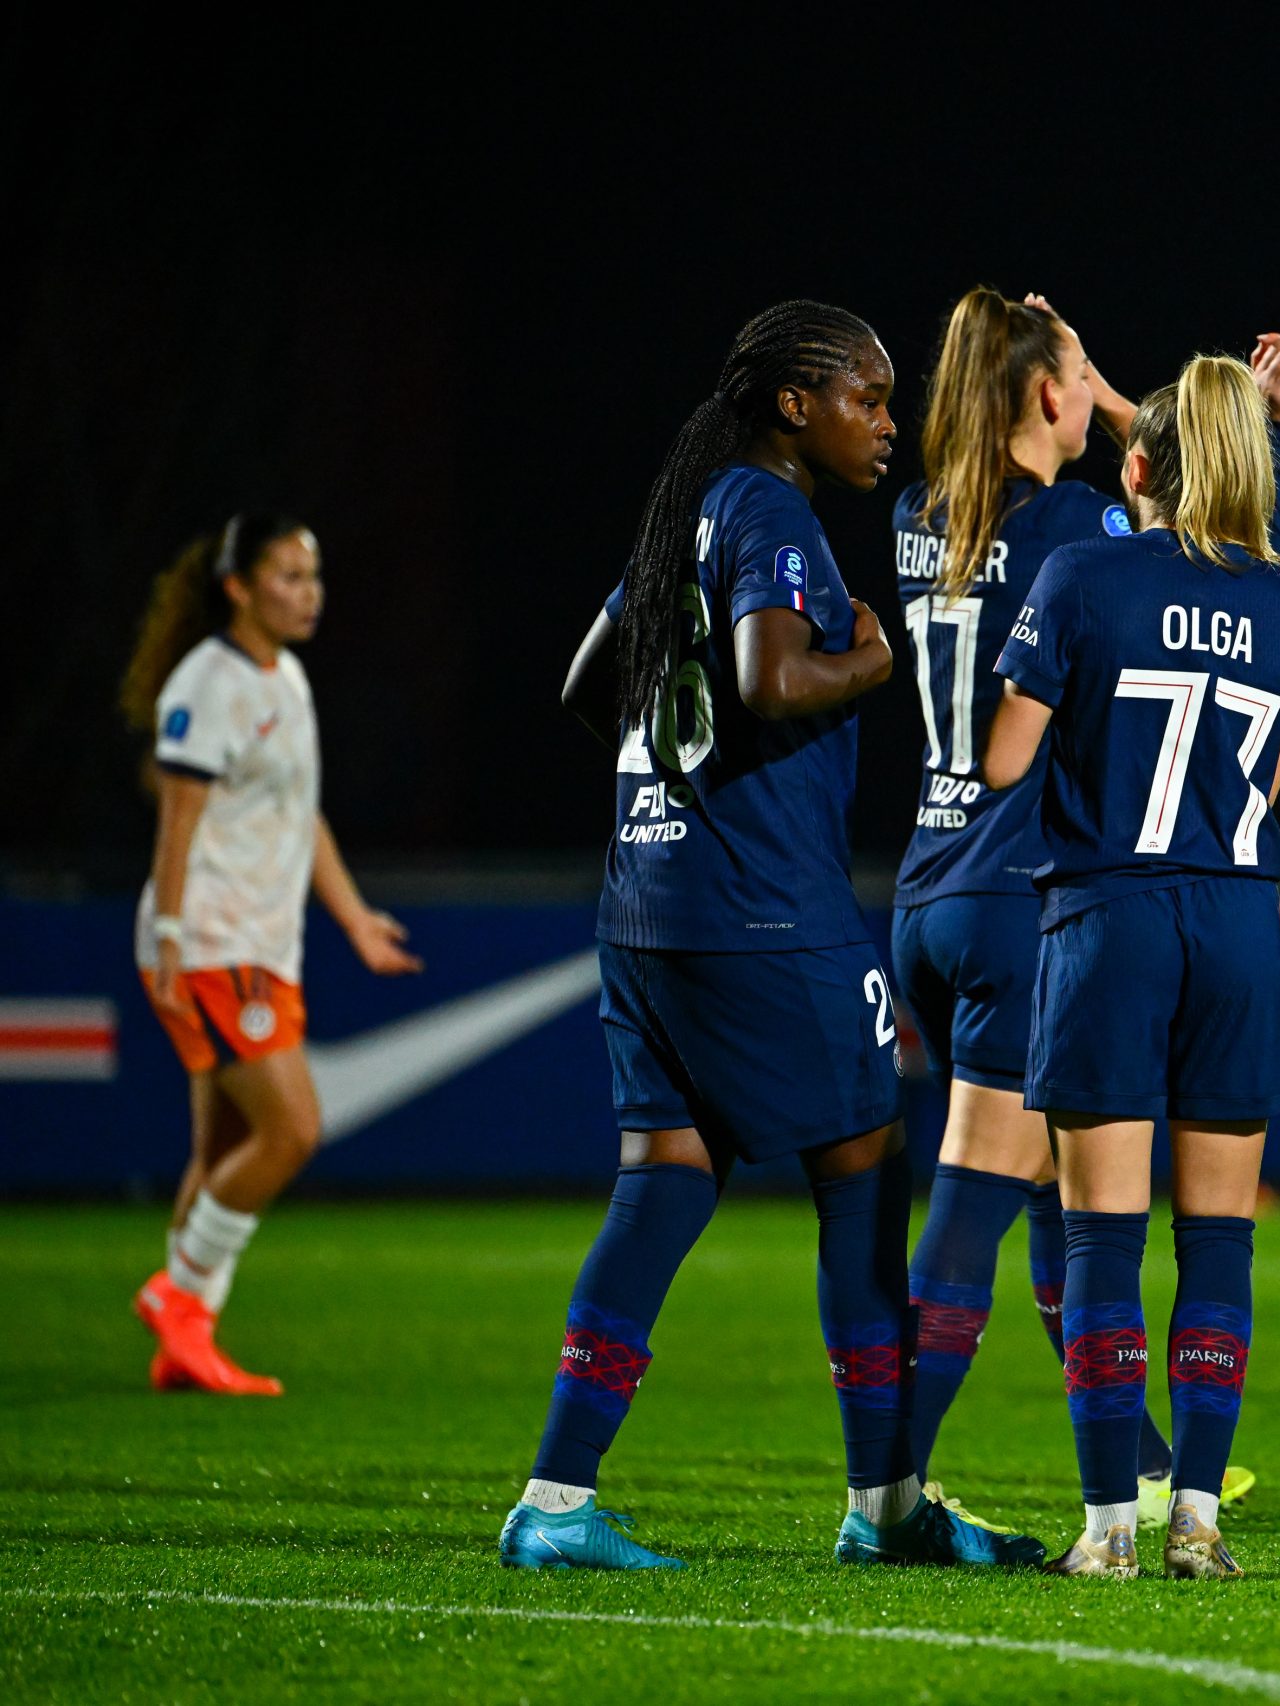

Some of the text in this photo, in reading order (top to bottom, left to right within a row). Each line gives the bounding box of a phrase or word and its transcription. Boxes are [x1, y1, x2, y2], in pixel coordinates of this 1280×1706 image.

[896, 530, 1009, 583] LEUCR
[1162, 604, 1253, 664] OLGA
[905, 594, 984, 775] 17
[619, 820, 687, 844] UNITED
[863, 964, 897, 1048] 2
[1179, 1349, 1235, 1368] PARIS
